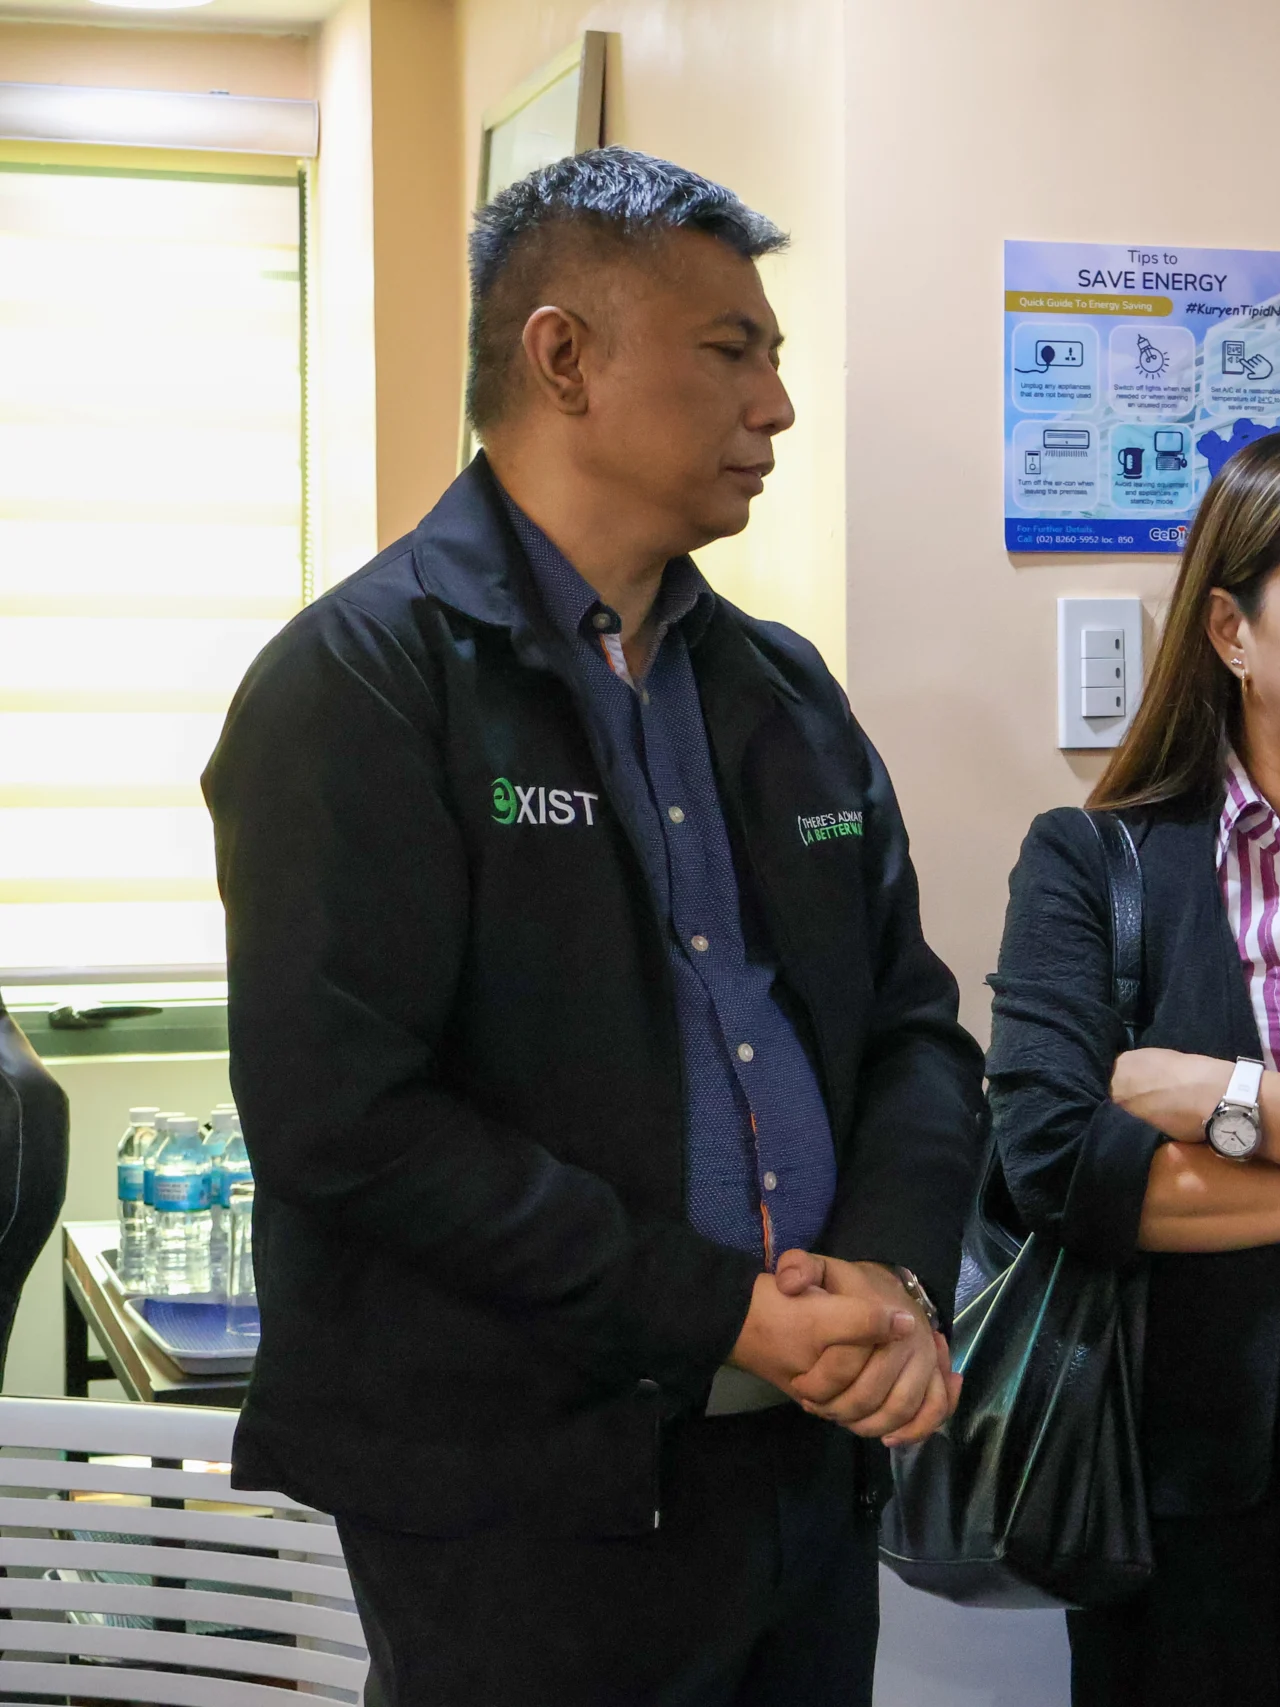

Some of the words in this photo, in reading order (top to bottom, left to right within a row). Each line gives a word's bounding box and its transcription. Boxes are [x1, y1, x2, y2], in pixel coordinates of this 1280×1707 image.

[1127, 249, 1159, 266] Tips
[1163, 252, 1178, 265] to
[1078, 269, 1136, 289] SAVE
[1142, 271, 1228, 292] ENERGY
[1019, 297, 1045, 308] Quick
[1046, 298, 1073, 309] Guide
[1076, 299, 1087, 309] To
[1089, 300, 1120, 311] Energy
[1122, 300, 1153, 312] Saving
[1020, 382, 1043, 390] Unplug
[1016, 524, 1031, 533] For
[1033, 525, 1063, 533] Further
[1036, 535, 1053, 545] (02)
[1055, 535, 1099, 544] 8260-5952
[1117, 536, 1134, 544] 850
[802, 812, 836, 829] THERE'S
[807, 830, 815, 844] A
[814, 822, 852, 841] BETTER
